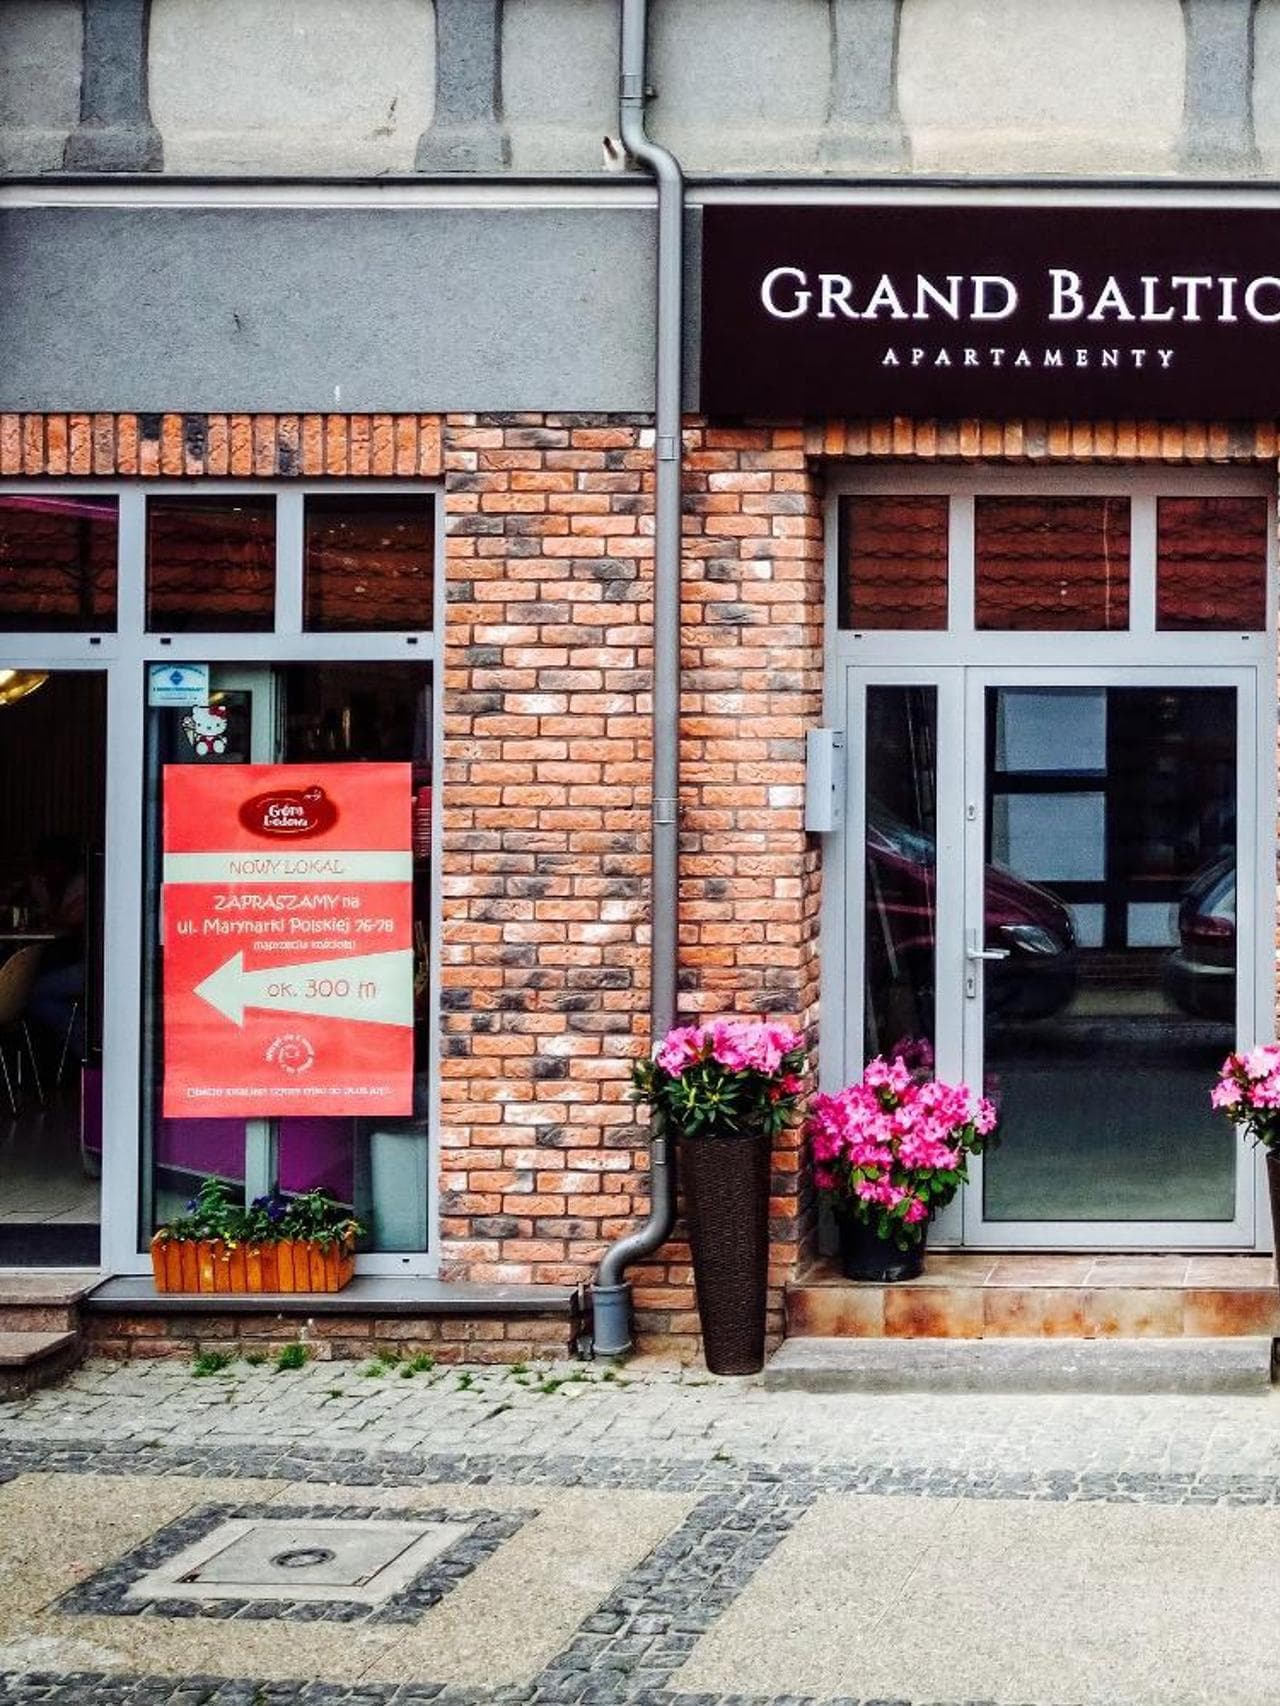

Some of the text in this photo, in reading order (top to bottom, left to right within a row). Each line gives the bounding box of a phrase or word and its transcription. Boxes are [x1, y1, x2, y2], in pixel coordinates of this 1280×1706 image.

[760, 267, 1018, 320] GRAND
[881, 347, 1176, 369] APARTAMENTY
[229, 859, 344, 874] NOWY LOKAL
[213, 894, 360, 911] ZAPRASZAMY na
[176, 919, 198, 934] ul.
[203, 919, 284, 935] Marynarki
[289, 918, 350, 935] Polskiej
[266, 980, 377, 998] ok. 300 m
